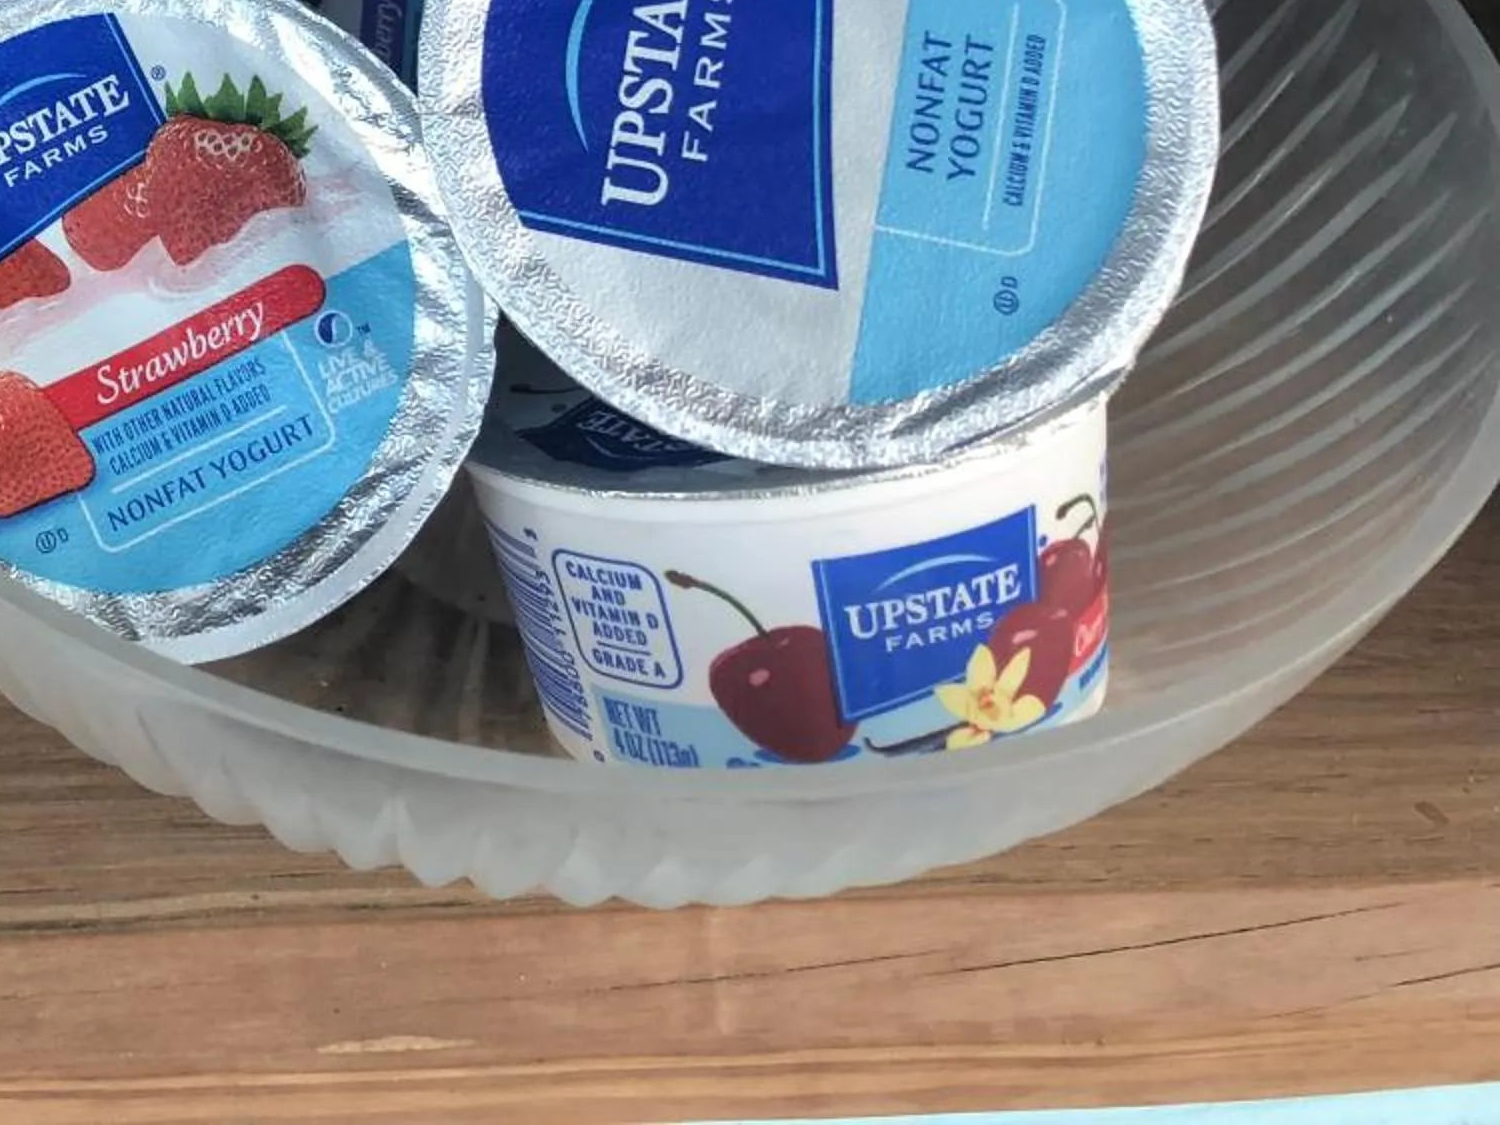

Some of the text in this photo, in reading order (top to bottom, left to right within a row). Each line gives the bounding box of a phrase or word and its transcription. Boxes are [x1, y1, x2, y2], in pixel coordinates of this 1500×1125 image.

[1022, 34, 1047, 76] ADDED
[905, 30, 953, 173] NONFAT
[946, 33, 994, 181] YOGURT
[1012, 87, 1039, 139] VITAMIN
[3, 124, 108, 188] FARMS
[1003, 151, 1030, 207] CALCIUM
[97, 301, 264, 405] Strawberry
[318, 347, 359, 380] LIVE
[326, 352, 391, 397] ACTIVE
[92, 356, 267, 455] WITH OTHER NATURAL FLAVORS
[109, 435, 163, 475] CALCIUM
[170, 405, 223, 444] VITAMIN
[219, 402, 232, 422] D
[231, 382, 271, 416] ADDED
[107, 412, 314, 532] NONFAT YOGURT
[566, 560, 642, 591] CALCIUM
[592, 585, 625, 606] AND
[571, 596, 659, 630] VITAMIN D
[844, 563, 1022, 640] UPSTATE
[593, 621, 648, 646] ADDED
[885, 611, 994, 654] FARMS
[592, 648, 667, 679] GRADE A
[603, 696, 661, 737] NET WT
